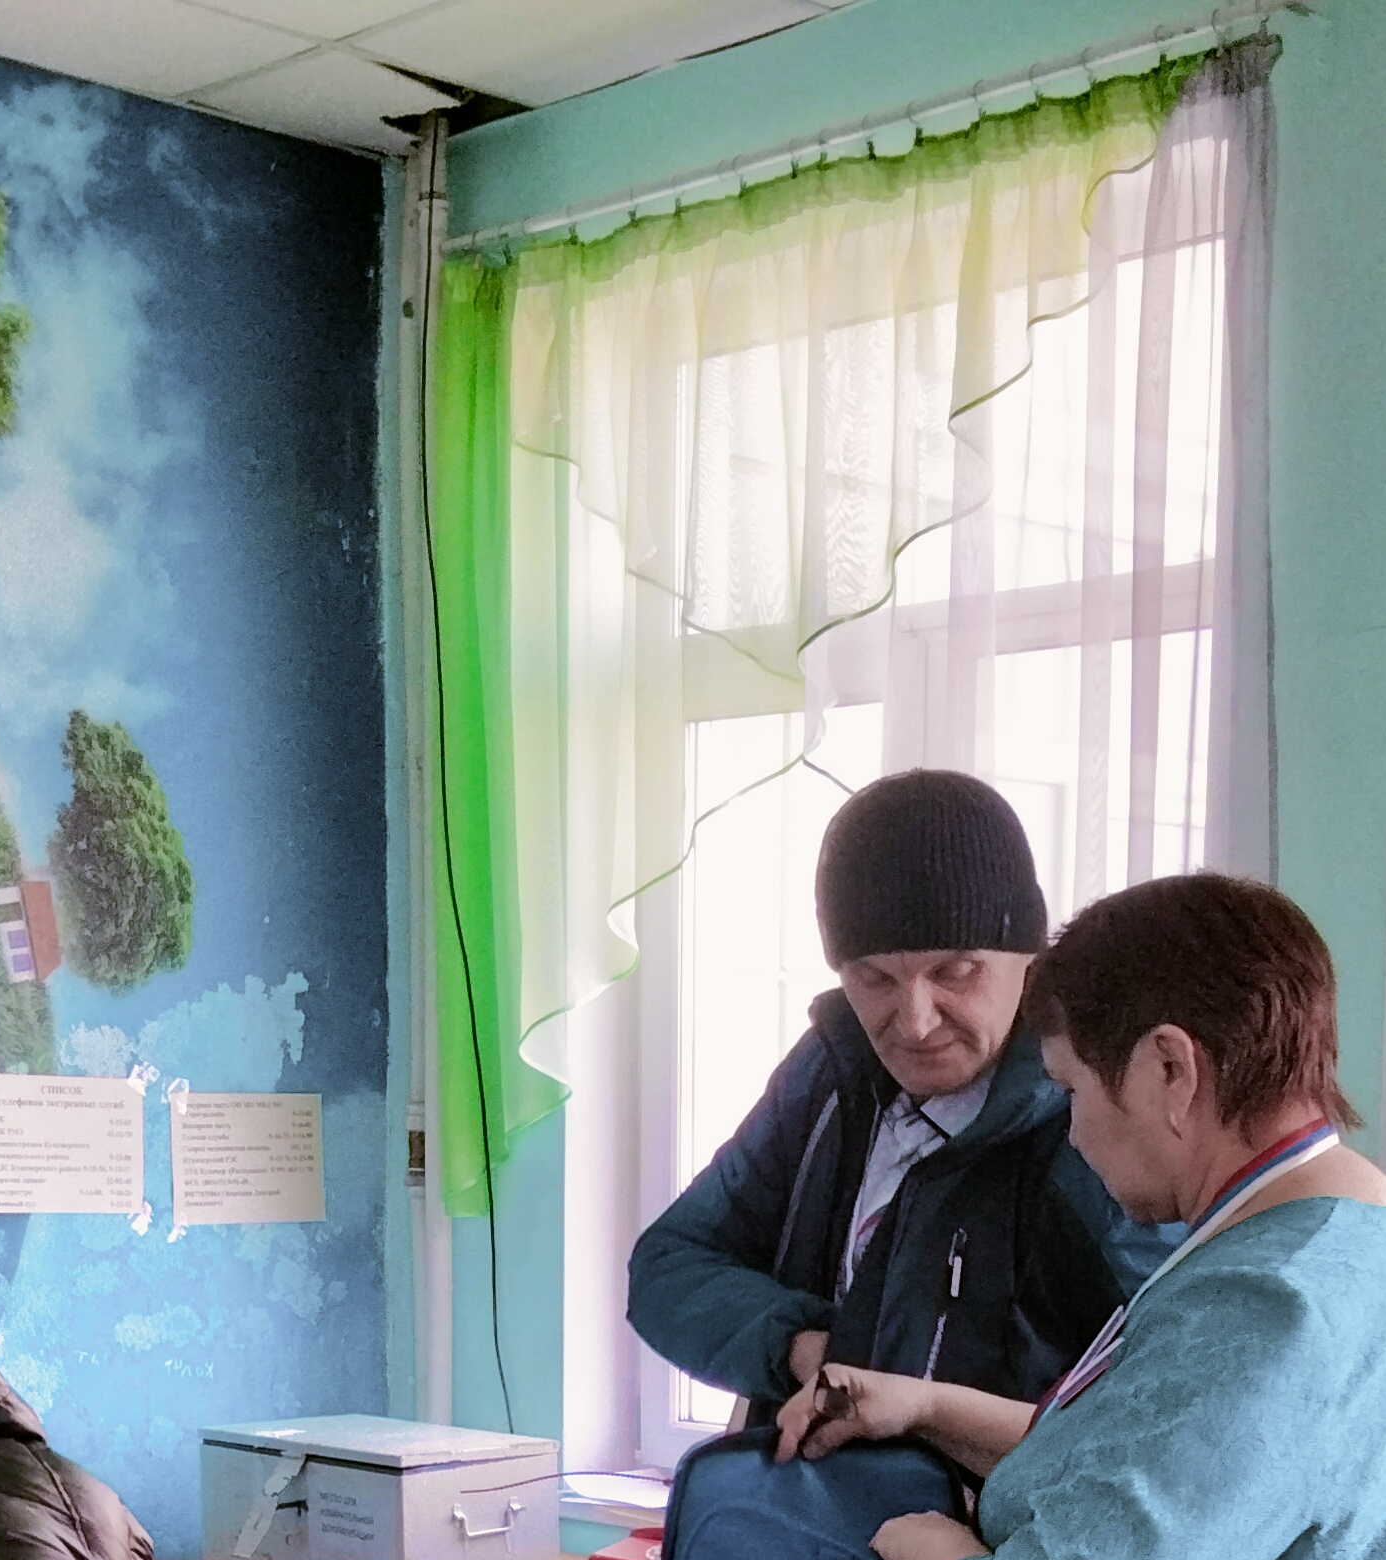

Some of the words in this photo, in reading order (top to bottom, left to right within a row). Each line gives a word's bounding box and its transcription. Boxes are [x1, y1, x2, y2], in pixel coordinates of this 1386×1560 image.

[40, 1085, 84, 1097] СПИСОК
[47, 1098, 97, 1110] экстренных
[98, 1100, 125, 1111] служб
